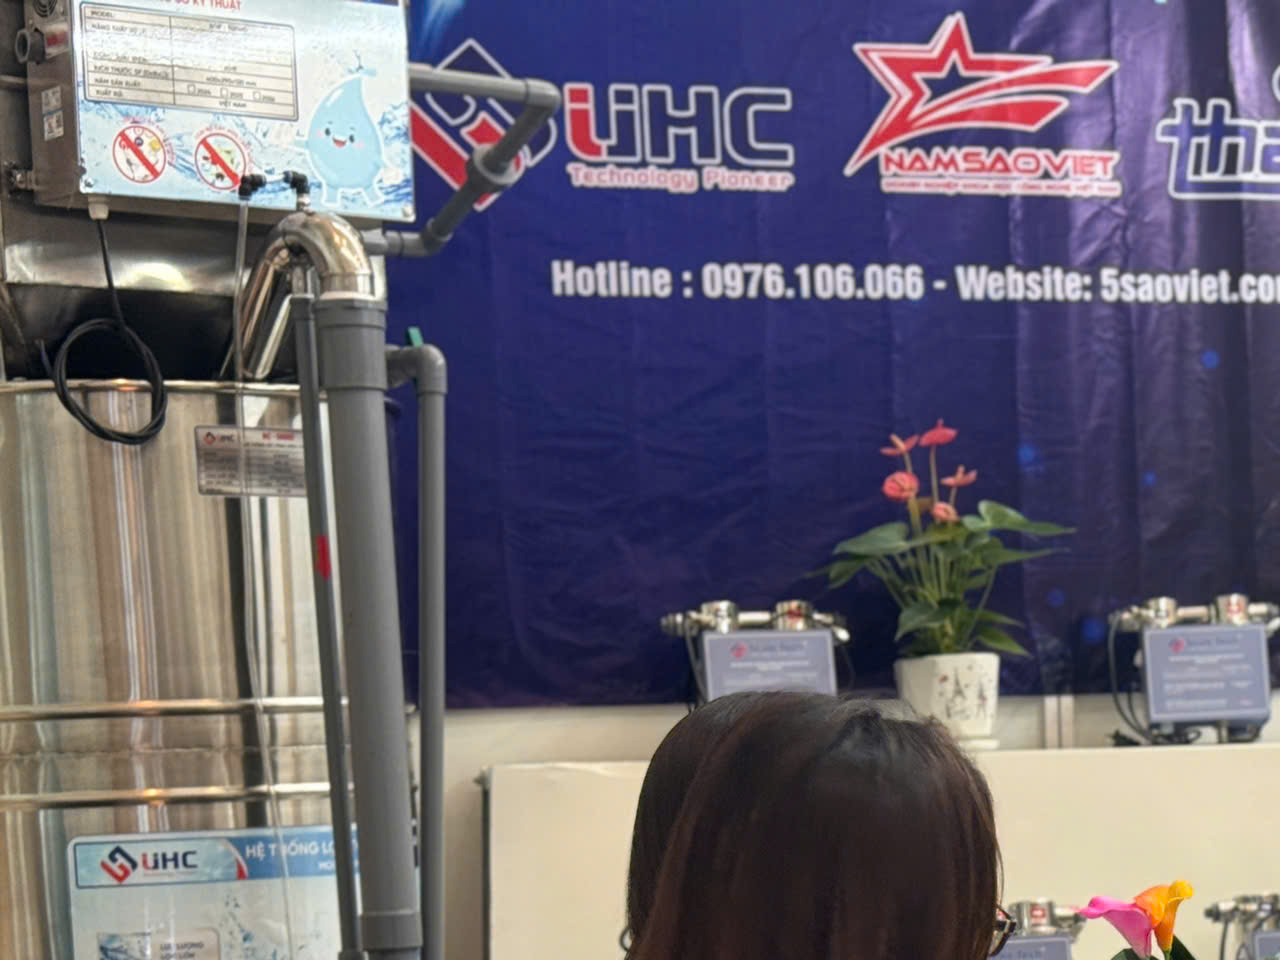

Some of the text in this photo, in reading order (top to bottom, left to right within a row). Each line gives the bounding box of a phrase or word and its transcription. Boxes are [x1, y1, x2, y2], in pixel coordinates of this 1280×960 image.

[567, 163, 795, 193] Technology Pioneer
[881, 149, 1118, 177] NAMSAOVIET
[551, 260, 672, 297] Hotline
[702, 263, 924, 299] 0976.106.066
[955, 265, 1092, 301] Website:
